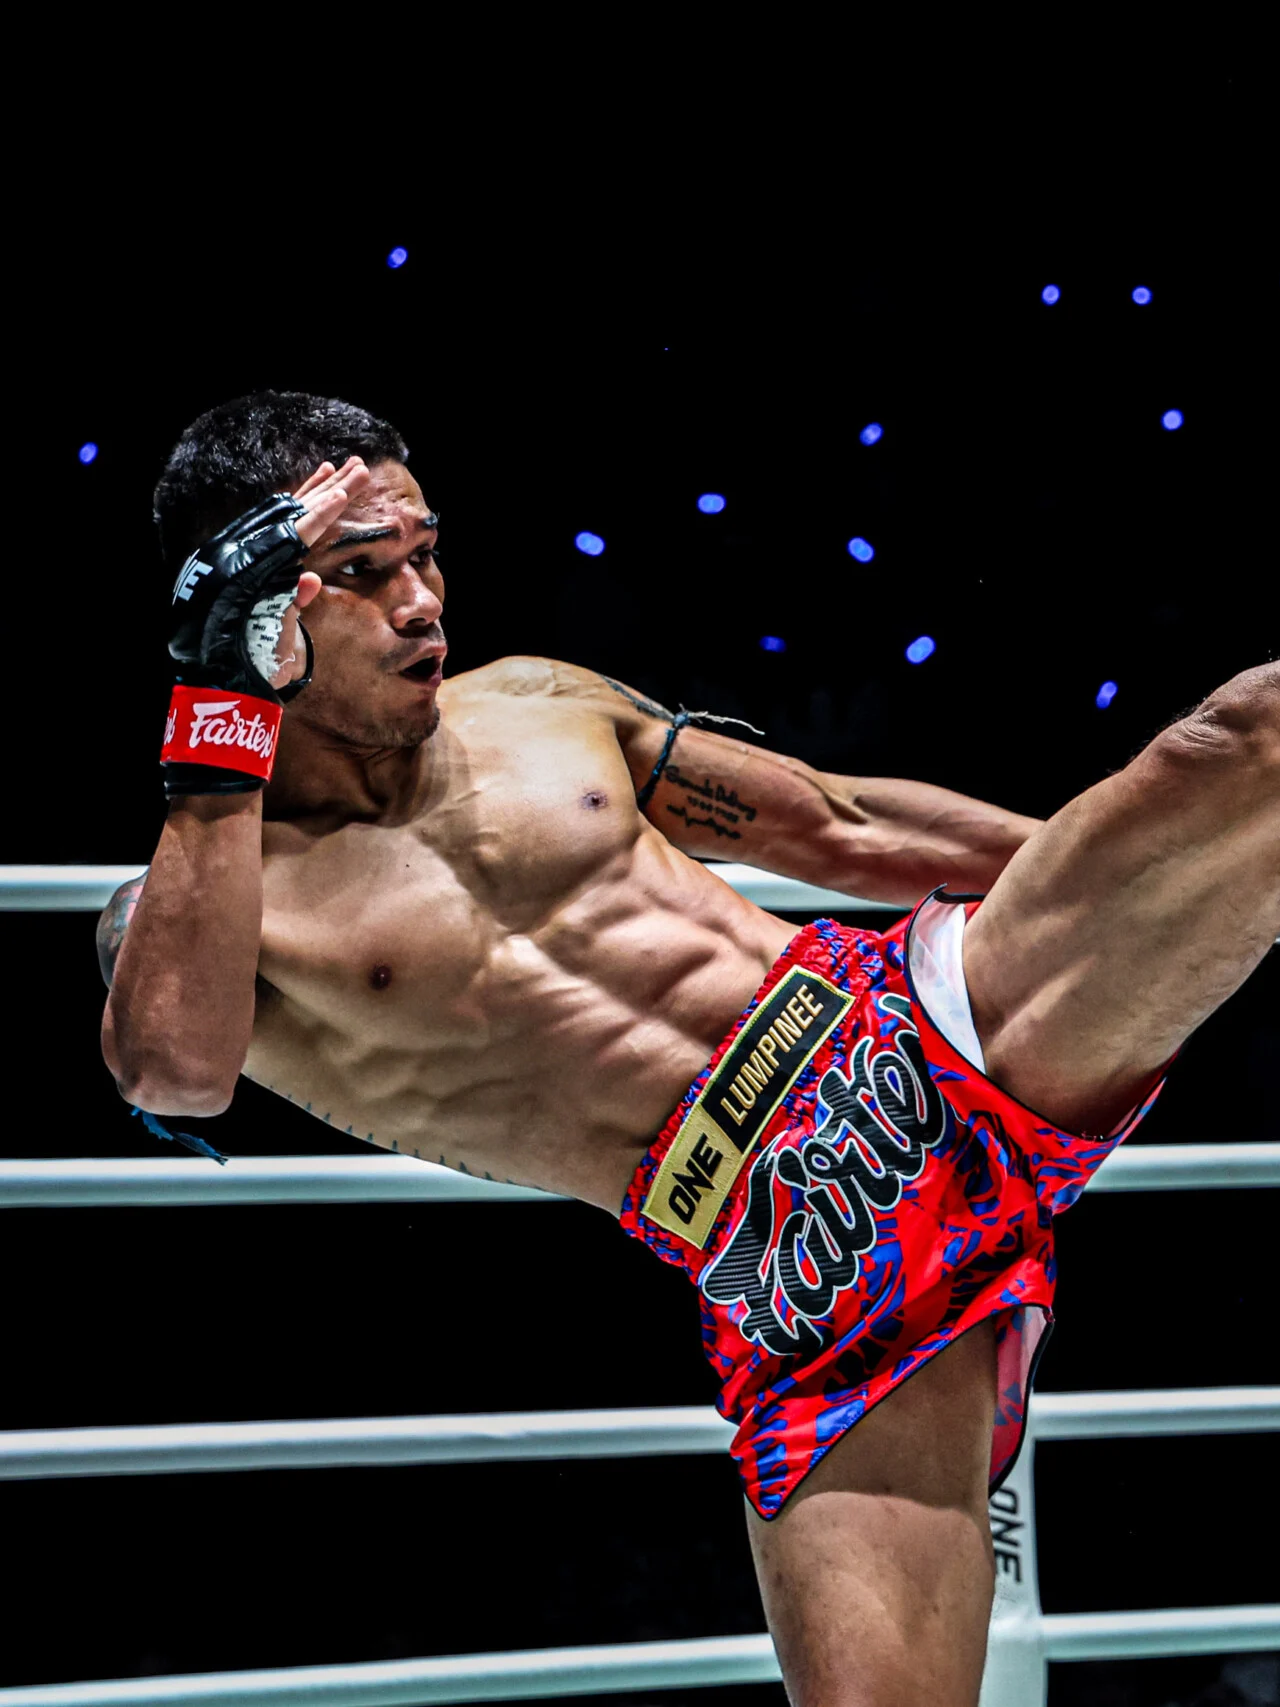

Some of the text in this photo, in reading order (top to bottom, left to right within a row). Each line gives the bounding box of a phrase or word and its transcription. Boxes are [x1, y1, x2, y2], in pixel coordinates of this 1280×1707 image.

[188, 699, 276, 759] Fairtex
[668, 983, 825, 1225] ONE LUMPINEE
[989, 1484, 1025, 1583] ONE
